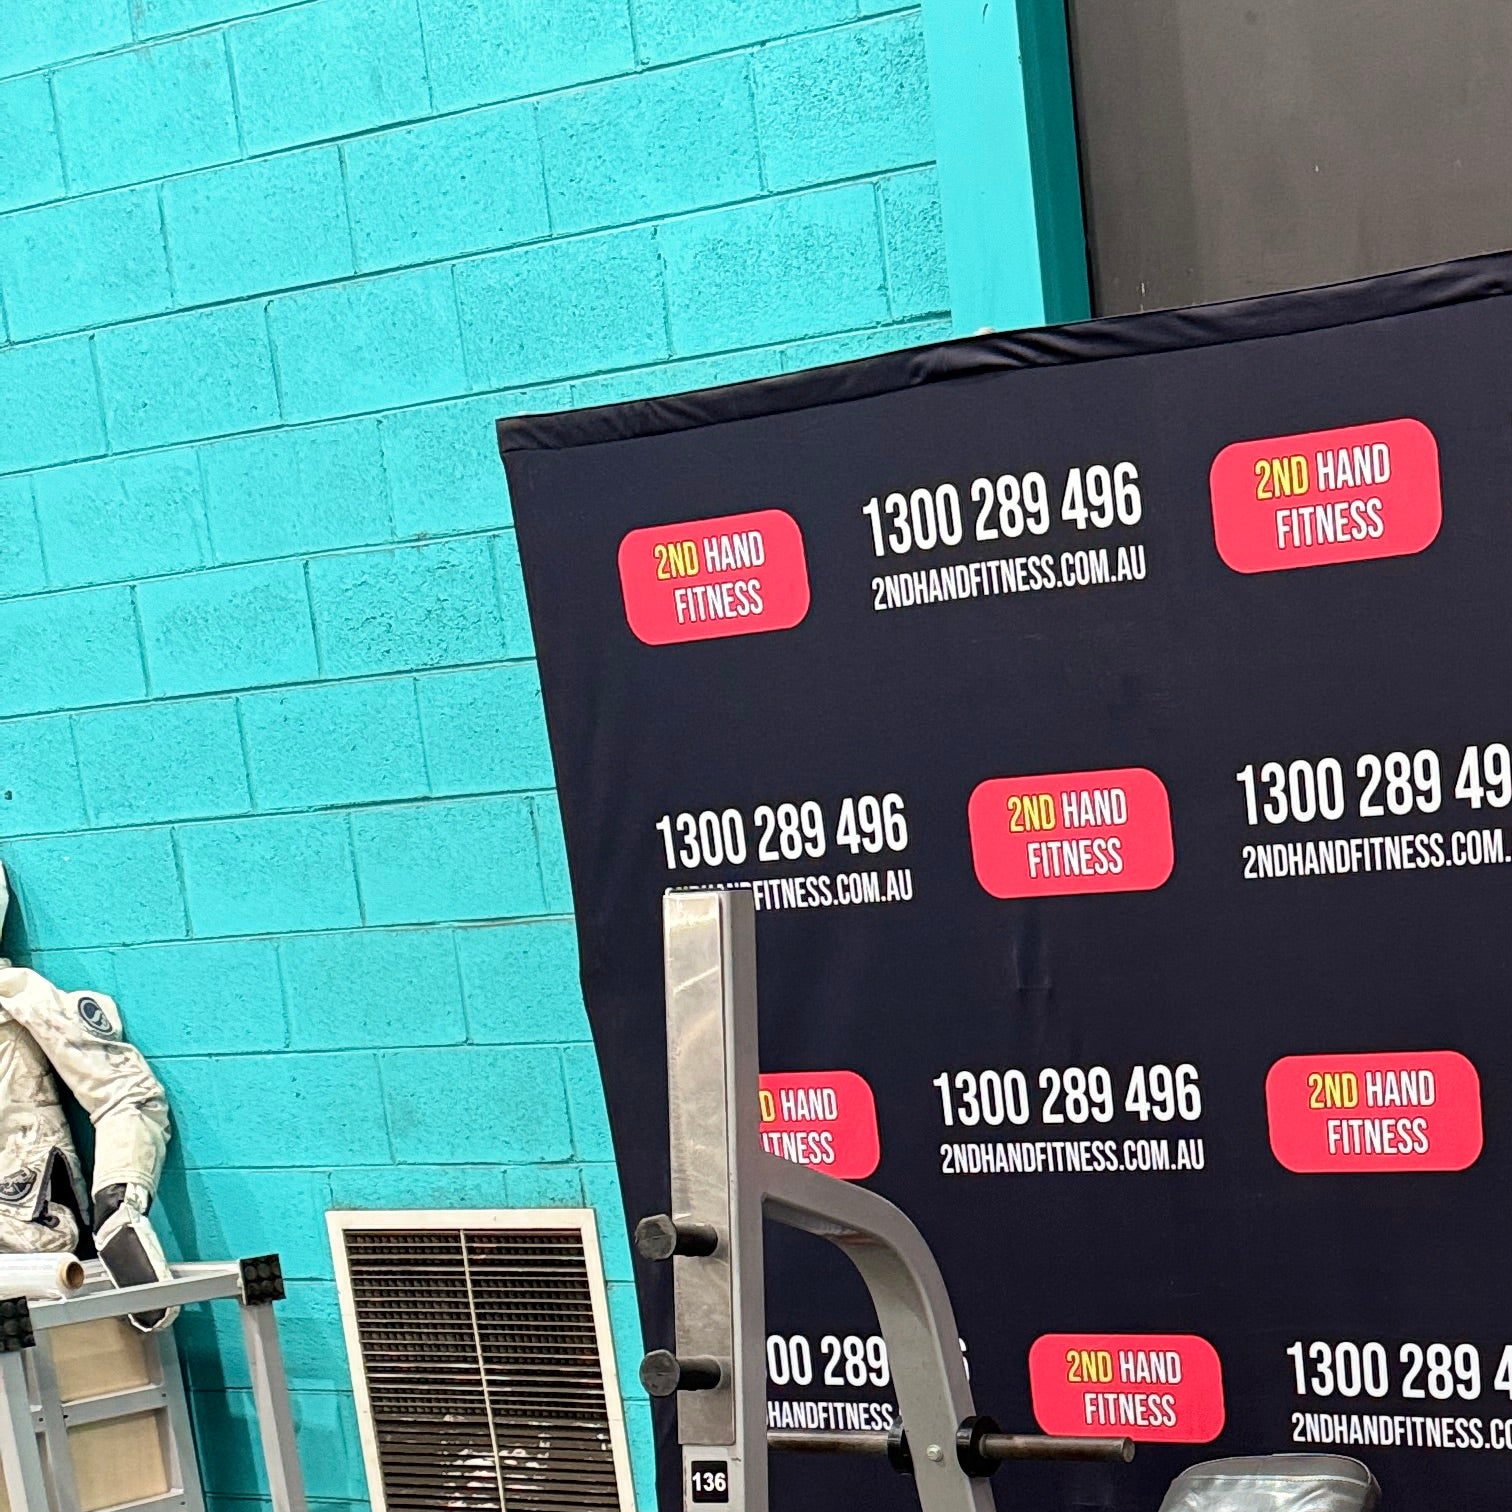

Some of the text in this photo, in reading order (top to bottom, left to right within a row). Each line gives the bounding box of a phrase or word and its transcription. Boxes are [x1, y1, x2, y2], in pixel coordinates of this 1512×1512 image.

[1255, 443, 1391, 500] 2ND HAND
[862, 461, 1142, 557] 1300 289 496
[1276, 497, 1384, 549] FITNESS
[654, 530, 765, 580] 2ND HAND
[871, 544, 1147, 611] 2NDHANDFITNESS.COM.AU
[674, 578, 764, 624] FITNESS
[1007, 788, 1128, 832] 2ND HAND
[1236, 757, 1345, 826] 1300
[1356, 749, 1442, 818] 289
[655, 792, 908, 870] 1300 289 496
[1027, 837, 1123, 878] FITNESS
[664, 869, 914, 911] FITNESS.COM.AU
[780, 1088, 838, 1122] HAND
[932, 1063, 1202, 1126] 1300 289 496
[1308, 1069, 1435, 1109] 2ND HAND
[759, 1131, 835, 1165] ITNESS
[940, 1138, 1205, 1174] 2NDHANDFITNESS.COM.AU
[1327, 1117, 1429, 1154] FITNESS
[820, 1335, 890, 1388] 289
[1066, 1350, 1182, 1384] 2ND HAND
[1286, 1341, 1389, 1398] 1300
[1399, 1342, 1481, 1400] 289
[1084, 1392, 1177, 1427] FITNESS
[692, 1471, 727, 1492] 136
